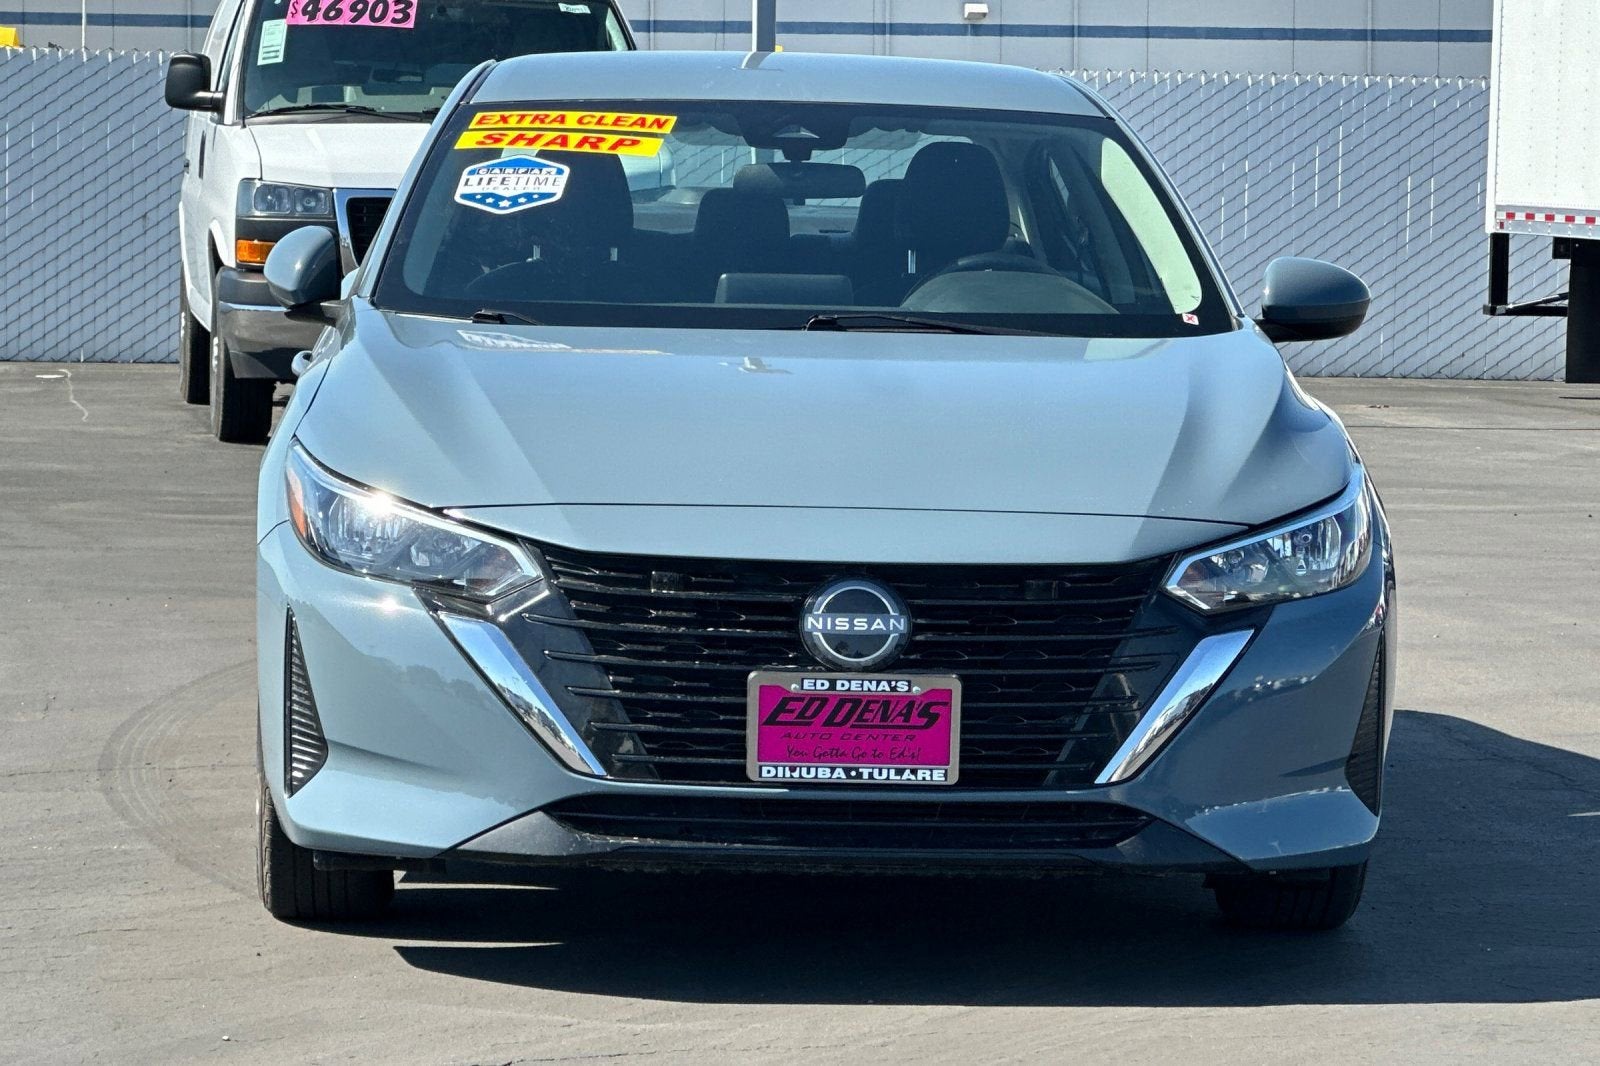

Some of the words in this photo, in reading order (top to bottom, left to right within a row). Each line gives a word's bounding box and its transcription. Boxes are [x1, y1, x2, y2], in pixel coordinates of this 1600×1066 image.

[475, 113, 568, 128] EXTRA
[576, 115, 672, 130] CLEAN
[475, 133, 642, 151] SHARP
[463, 176, 563, 187] LIFETIME
[807, 616, 905, 631] NISSAN
[803, 679, 830, 691] ED
[836, 680, 909, 692] DENA'S
[762, 697, 830, 727] ED
[780, 732, 832, 741] AUTO
[840, 733, 917, 742] CENTER
[786, 745, 808, 758] You
[813, 745, 847, 761] Gotta
[851, 746, 867, 761] Go
[871, 747, 884, 759] to
[761, 766, 847, 779] DINUBA
[859, 768, 946, 781] TULARE
